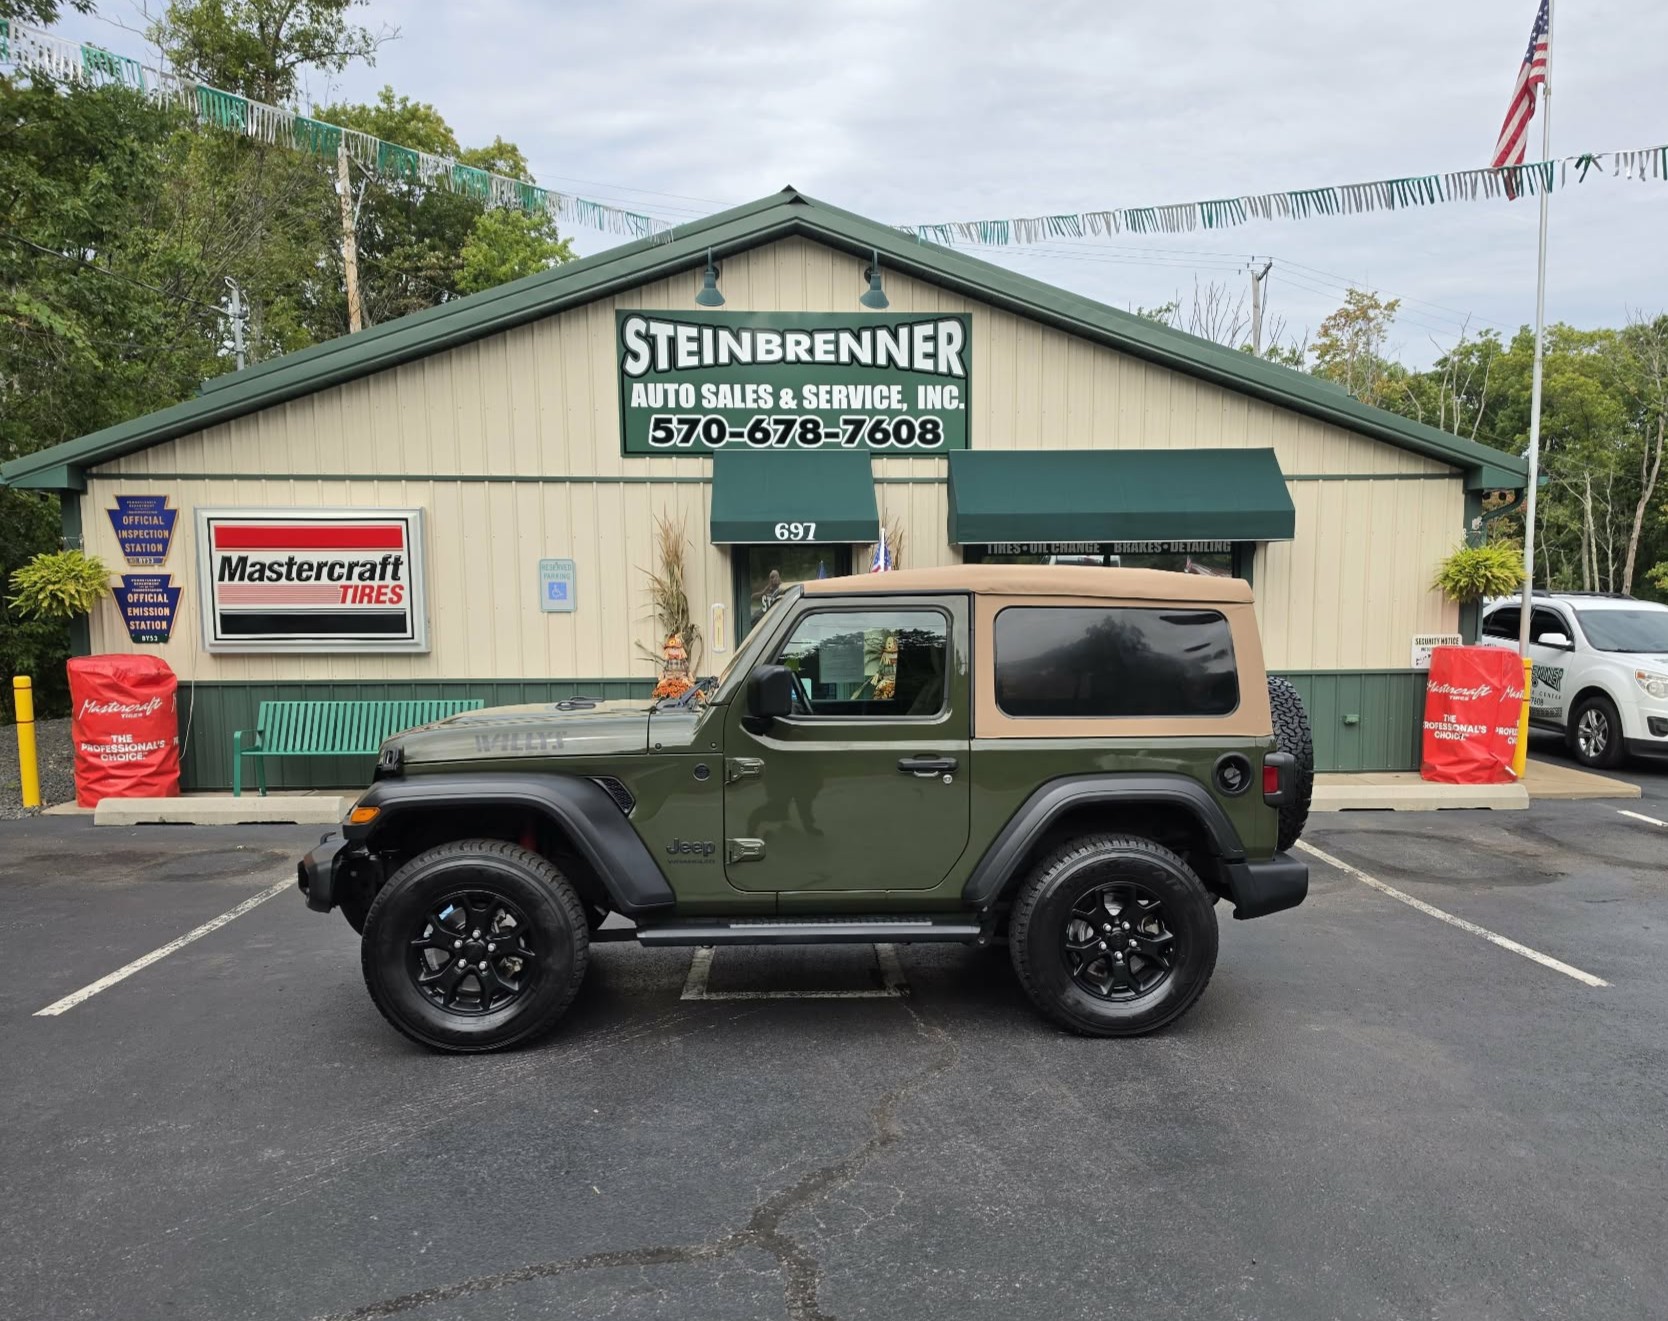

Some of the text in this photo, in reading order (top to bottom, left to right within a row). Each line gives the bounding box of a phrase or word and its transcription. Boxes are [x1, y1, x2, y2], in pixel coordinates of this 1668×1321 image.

[623, 316, 966, 376] STEINBRENNER
[630, 383, 965, 412] AUTO SALES & SERVICE, INC.
[649, 415, 944, 447] 570-678-7608
[122, 515, 164, 525] OFFICIAL
[118, 530, 169, 539] INSPECTION
[774, 522, 816, 541] 697
[125, 543, 163, 552] STATION
[987, 543, 1021, 554] TIRES
[1051, 543, 1100, 553] CHANGE
[1113, 541, 1231, 553] BRAKES DETAILING
[217, 554, 403, 582] Mastercraft
[127, 593, 168, 603] OFFICIAL
[339, 583, 405, 605] TIRES
[127, 607, 170, 616] EMISSION
[129, 621, 167, 630] STATION
[1415, 637, 1440, 645] SECURITY
[1531, 697, 1544, 707] 7608
[79, 696, 162, 720] Mastercraft
[1443, 714, 1457, 723] THE
[111, 734, 133, 743] THE
[475, 731, 568, 752] WILLYS
[81, 740, 165, 753] PROFESSIONAL'S
[666, 837, 716, 857] Jeep
